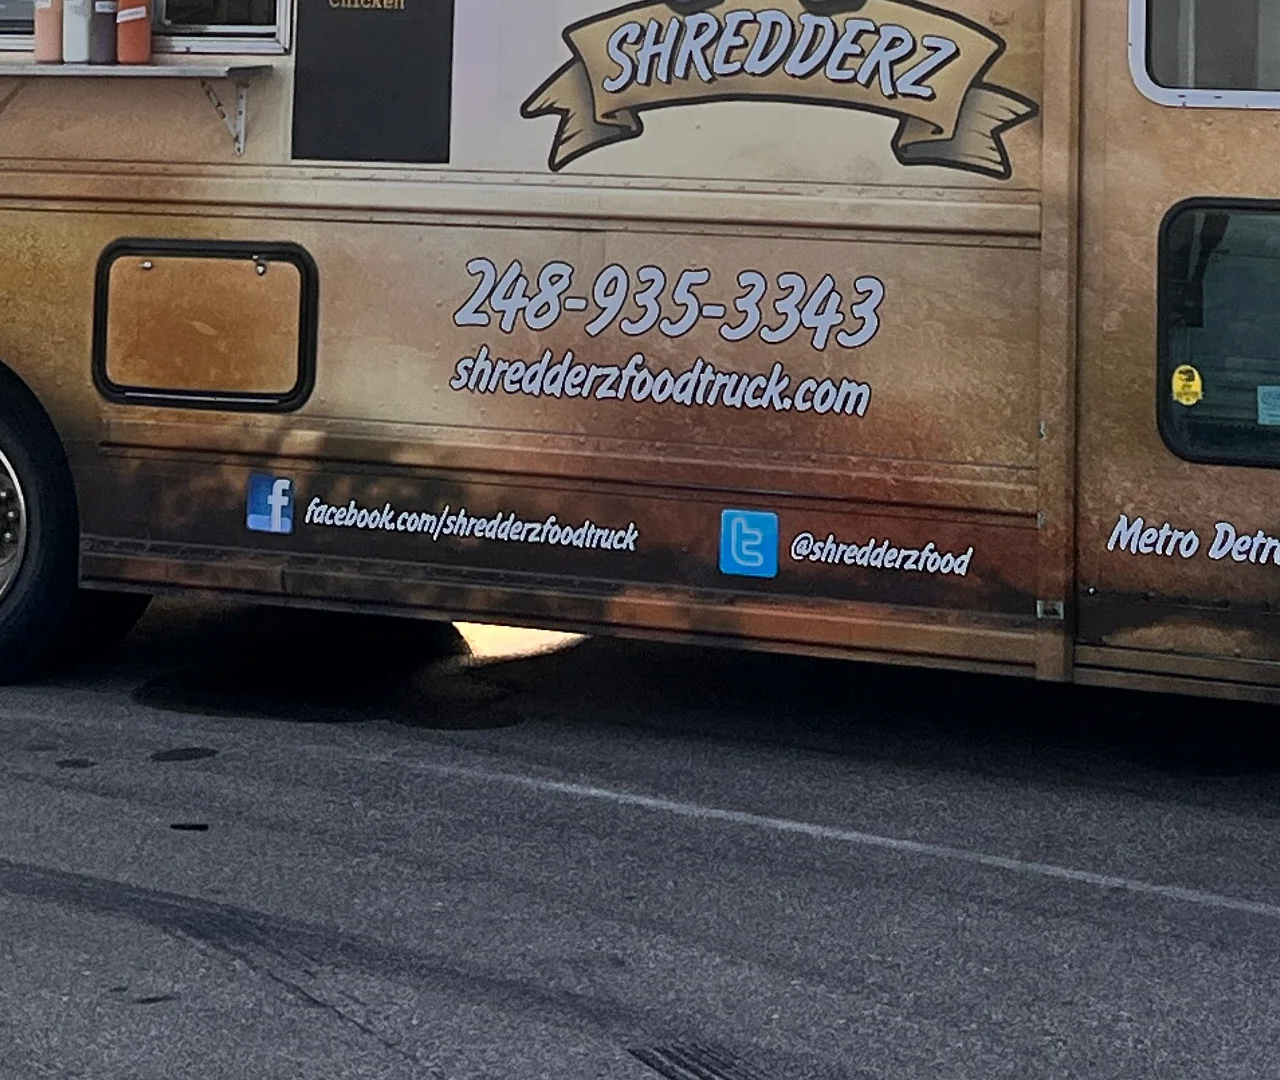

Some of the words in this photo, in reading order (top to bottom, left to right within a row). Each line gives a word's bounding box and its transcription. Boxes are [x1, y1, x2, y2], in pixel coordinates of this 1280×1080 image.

[602, 8, 959, 100] SHREDDERZ
[453, 257, 886, 350] 248-935-3343
[450, 345, 871, 417] shredderzfoodtruck.com
[305, 496, 639, 552] facebook.com/shredderzfoodtruck
[791, 532, 974, 576] @shredderzfood
[1107, 514, 1200, 559] Metro
